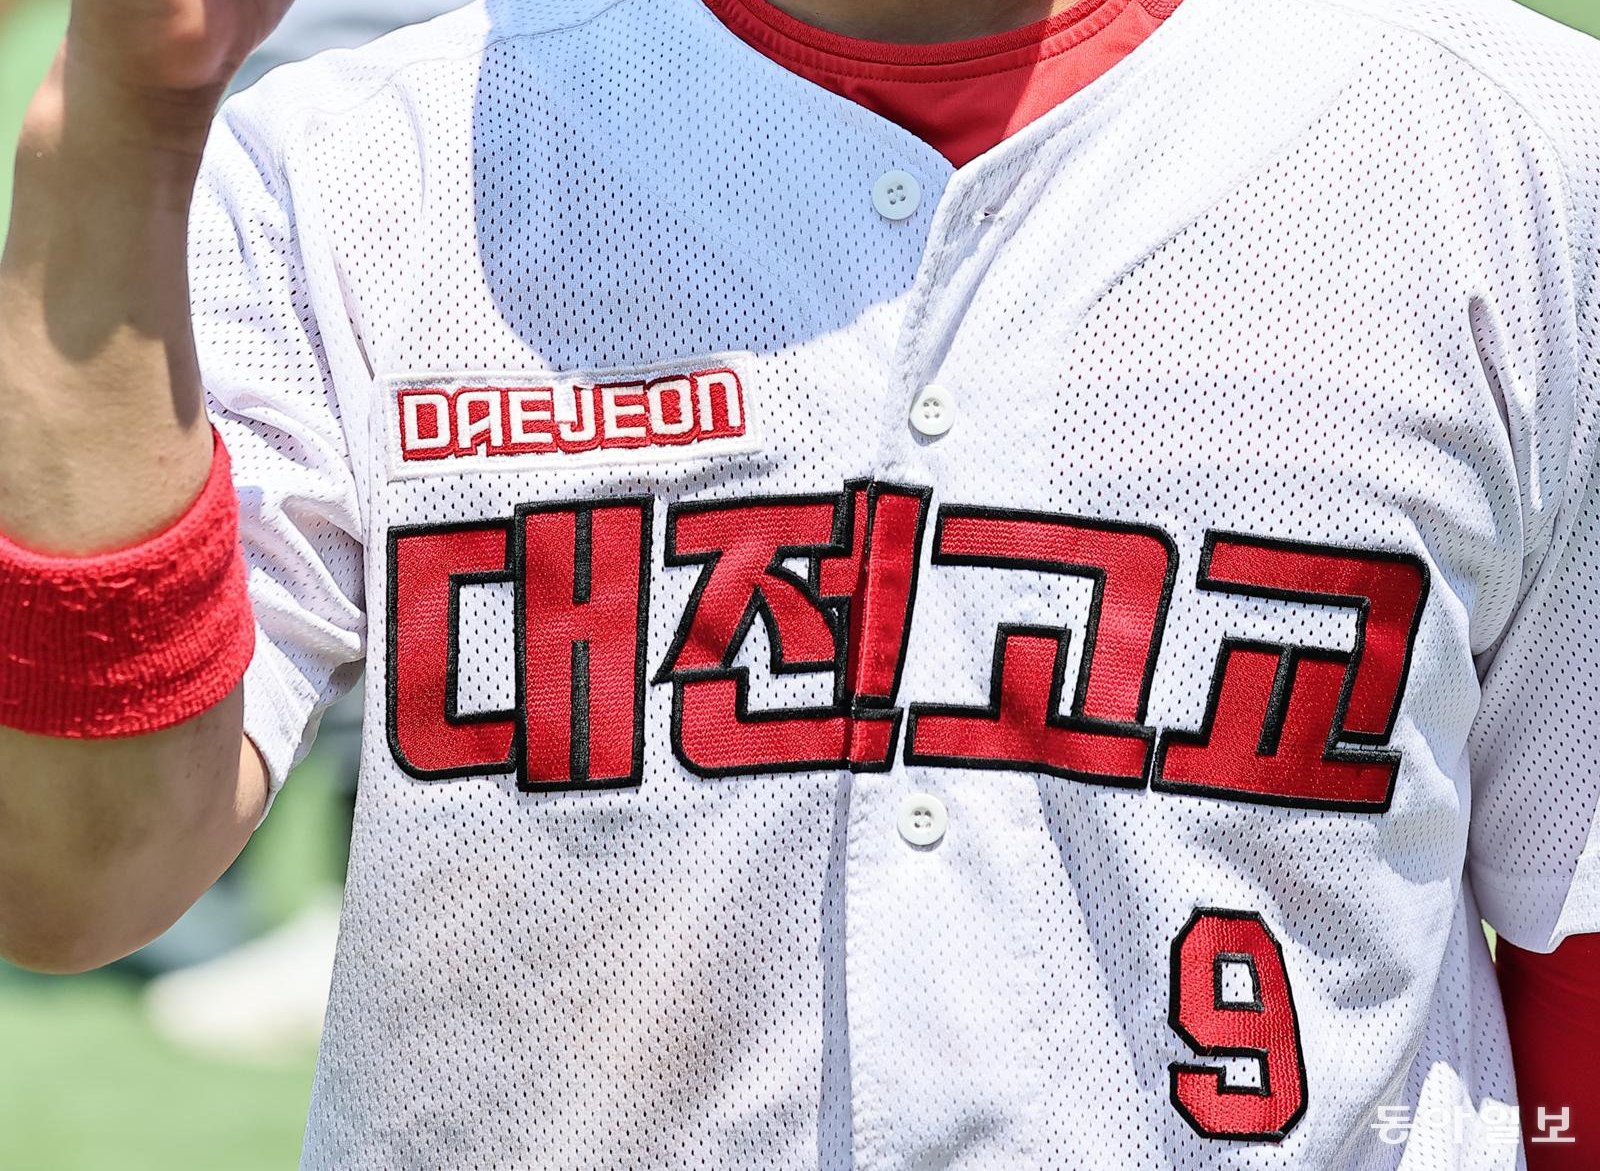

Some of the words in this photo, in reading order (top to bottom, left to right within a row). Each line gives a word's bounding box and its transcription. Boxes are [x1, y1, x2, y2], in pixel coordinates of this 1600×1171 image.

[398, 367, 747, 462] DAEJEON
[386, 477, 1431, 813] 대전고교
[1168, 906, 1309, 1143] 9
